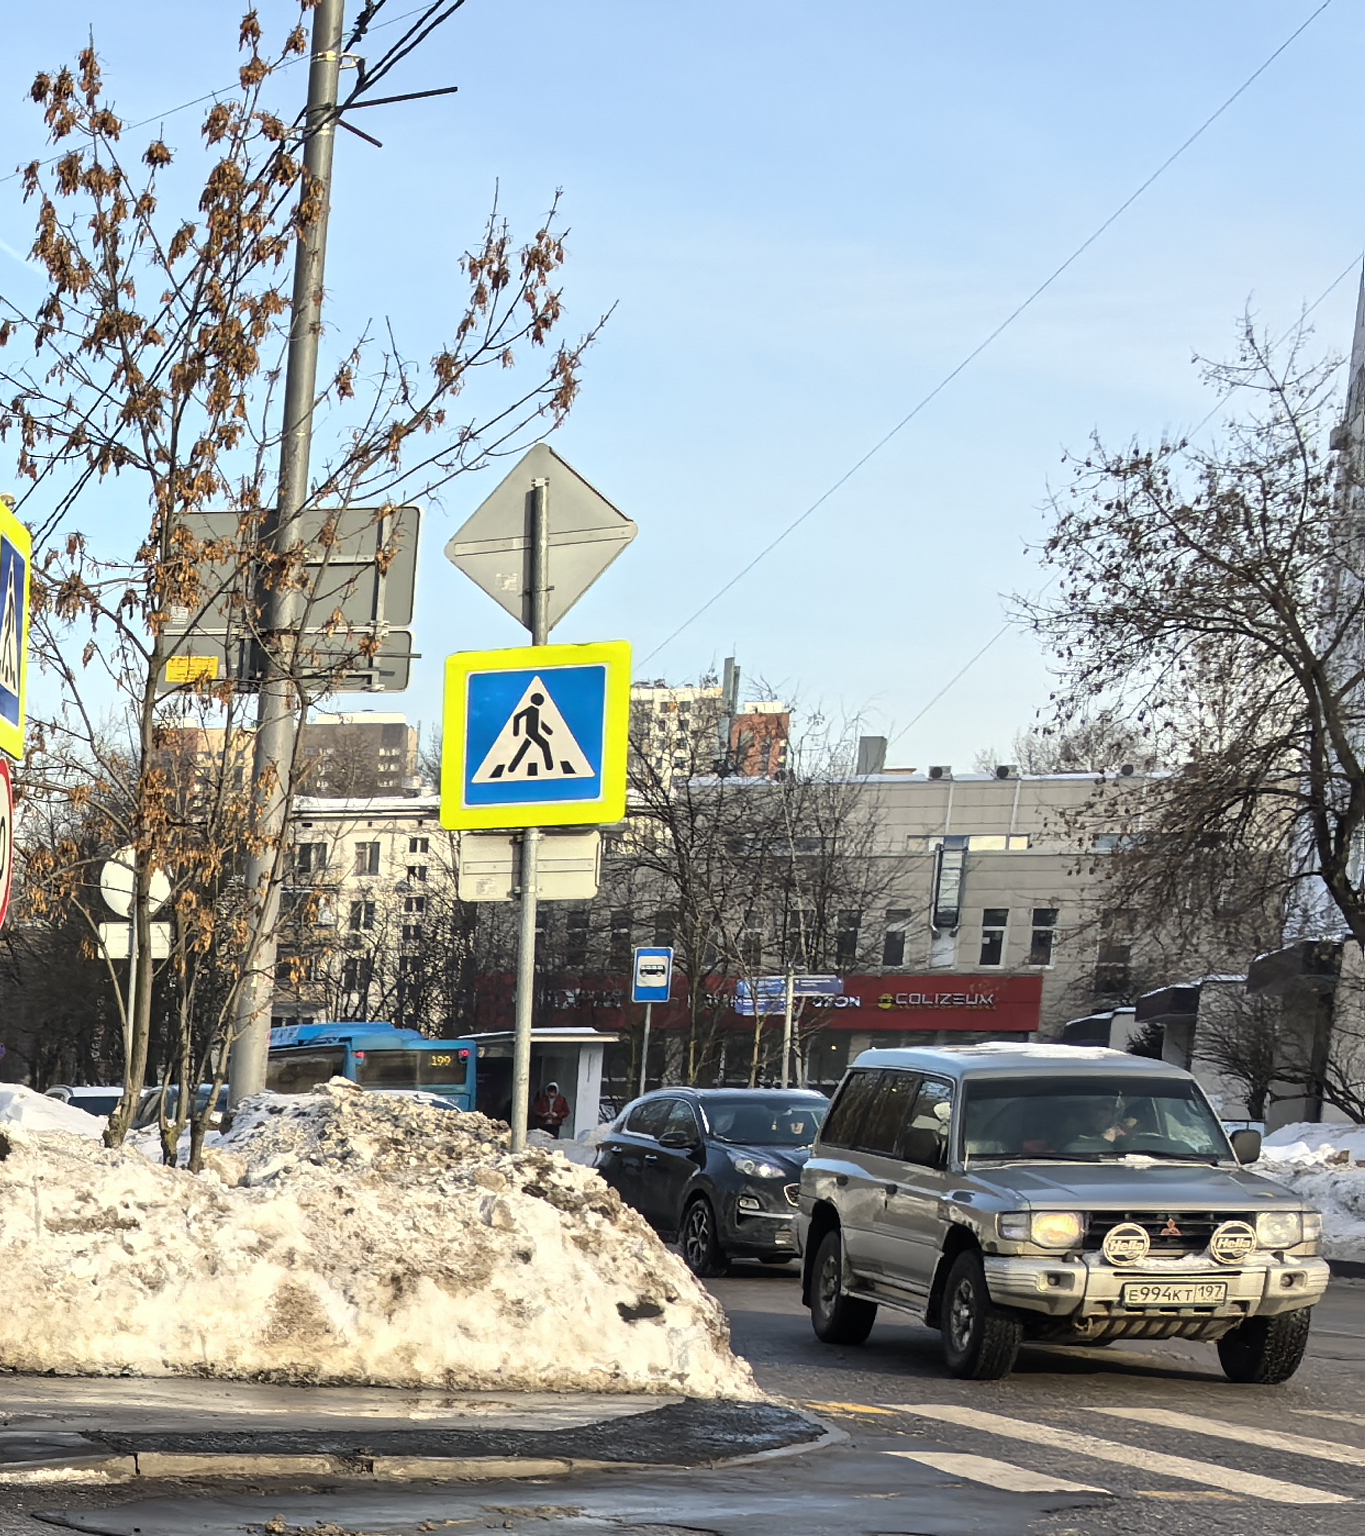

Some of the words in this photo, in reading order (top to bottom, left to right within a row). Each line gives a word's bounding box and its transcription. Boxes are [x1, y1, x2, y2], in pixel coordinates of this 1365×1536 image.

[1108, 1239, 1145, 1250] Hella
[1218, 1237, 1252, 1249] Hella
[1197, 1285, 1222, 1298] 197
